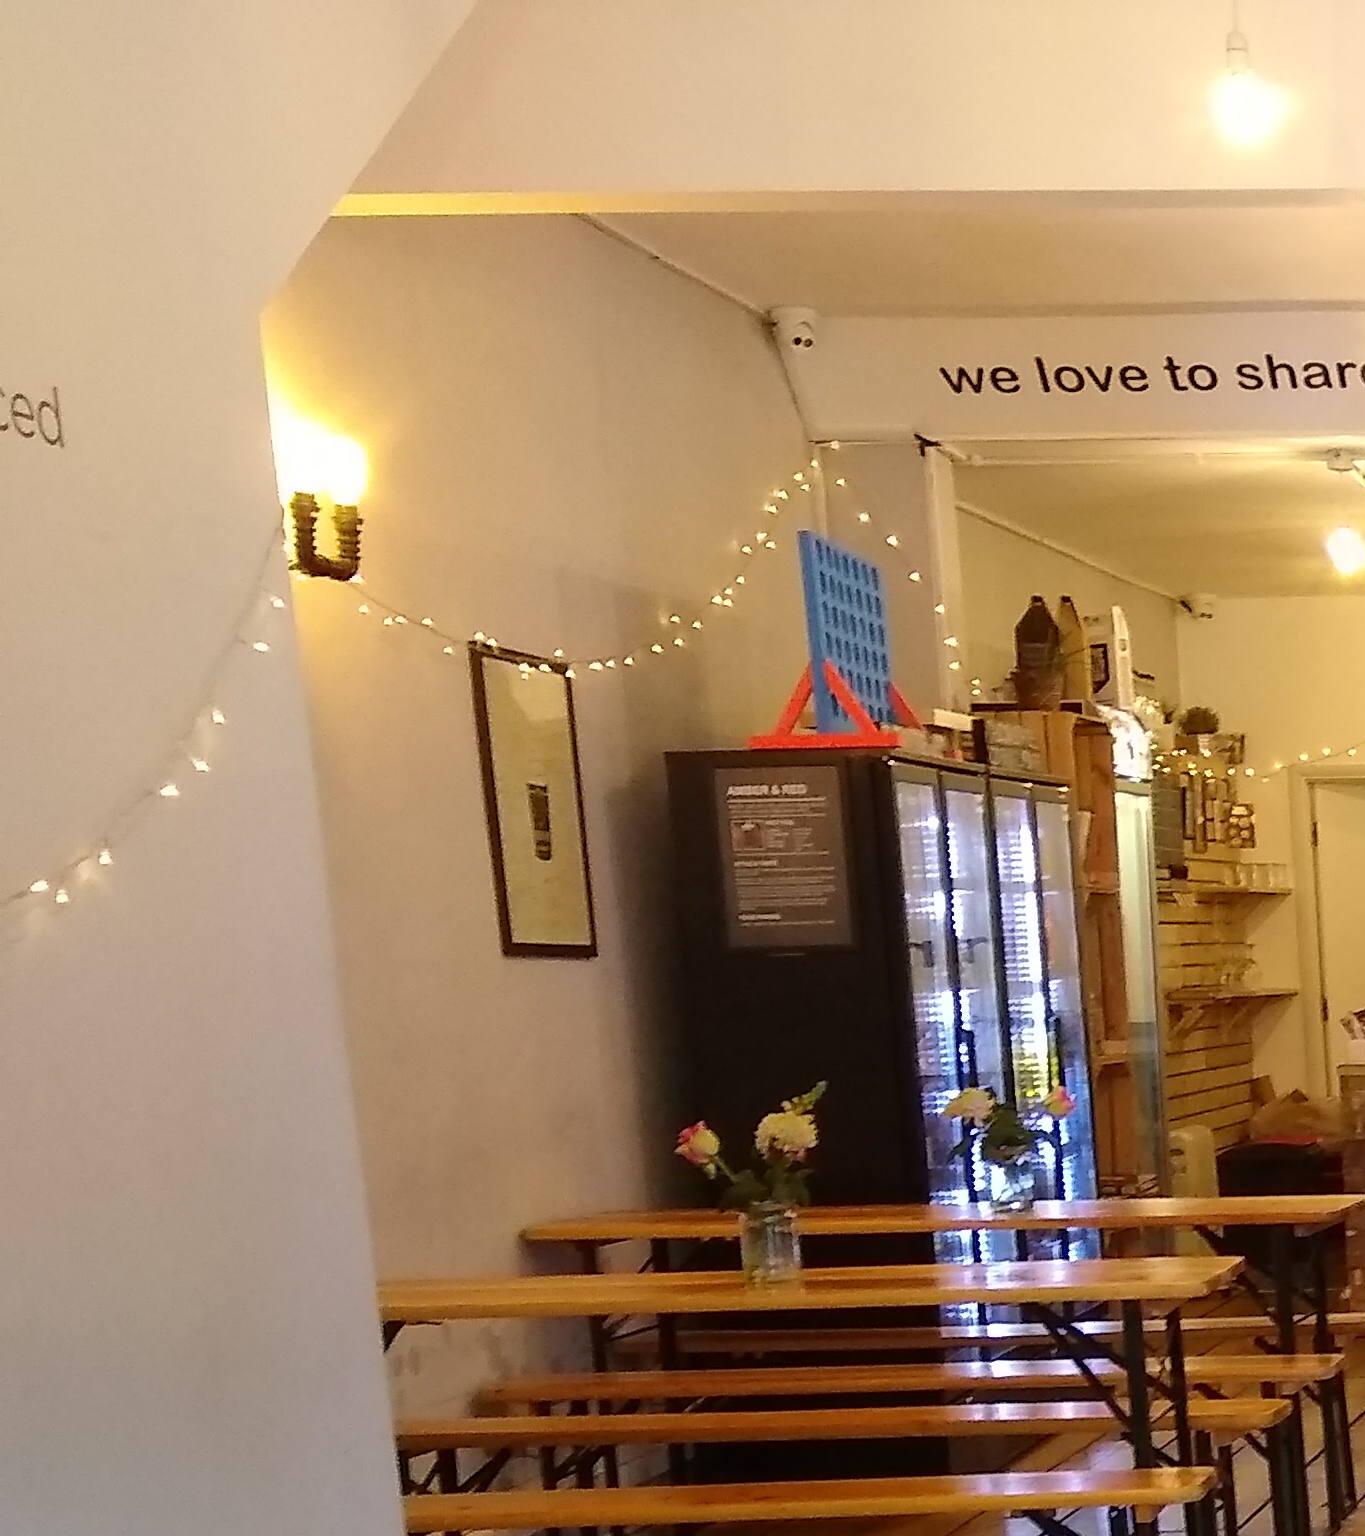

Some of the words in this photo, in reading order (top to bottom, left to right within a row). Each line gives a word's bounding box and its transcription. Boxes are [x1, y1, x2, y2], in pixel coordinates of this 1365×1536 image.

[938, 365, 1021, 394] we
[1034, 356, 1149, 393] love
[1163, 355, 1218, 392] to
[0, 386, 65, 448] ed
